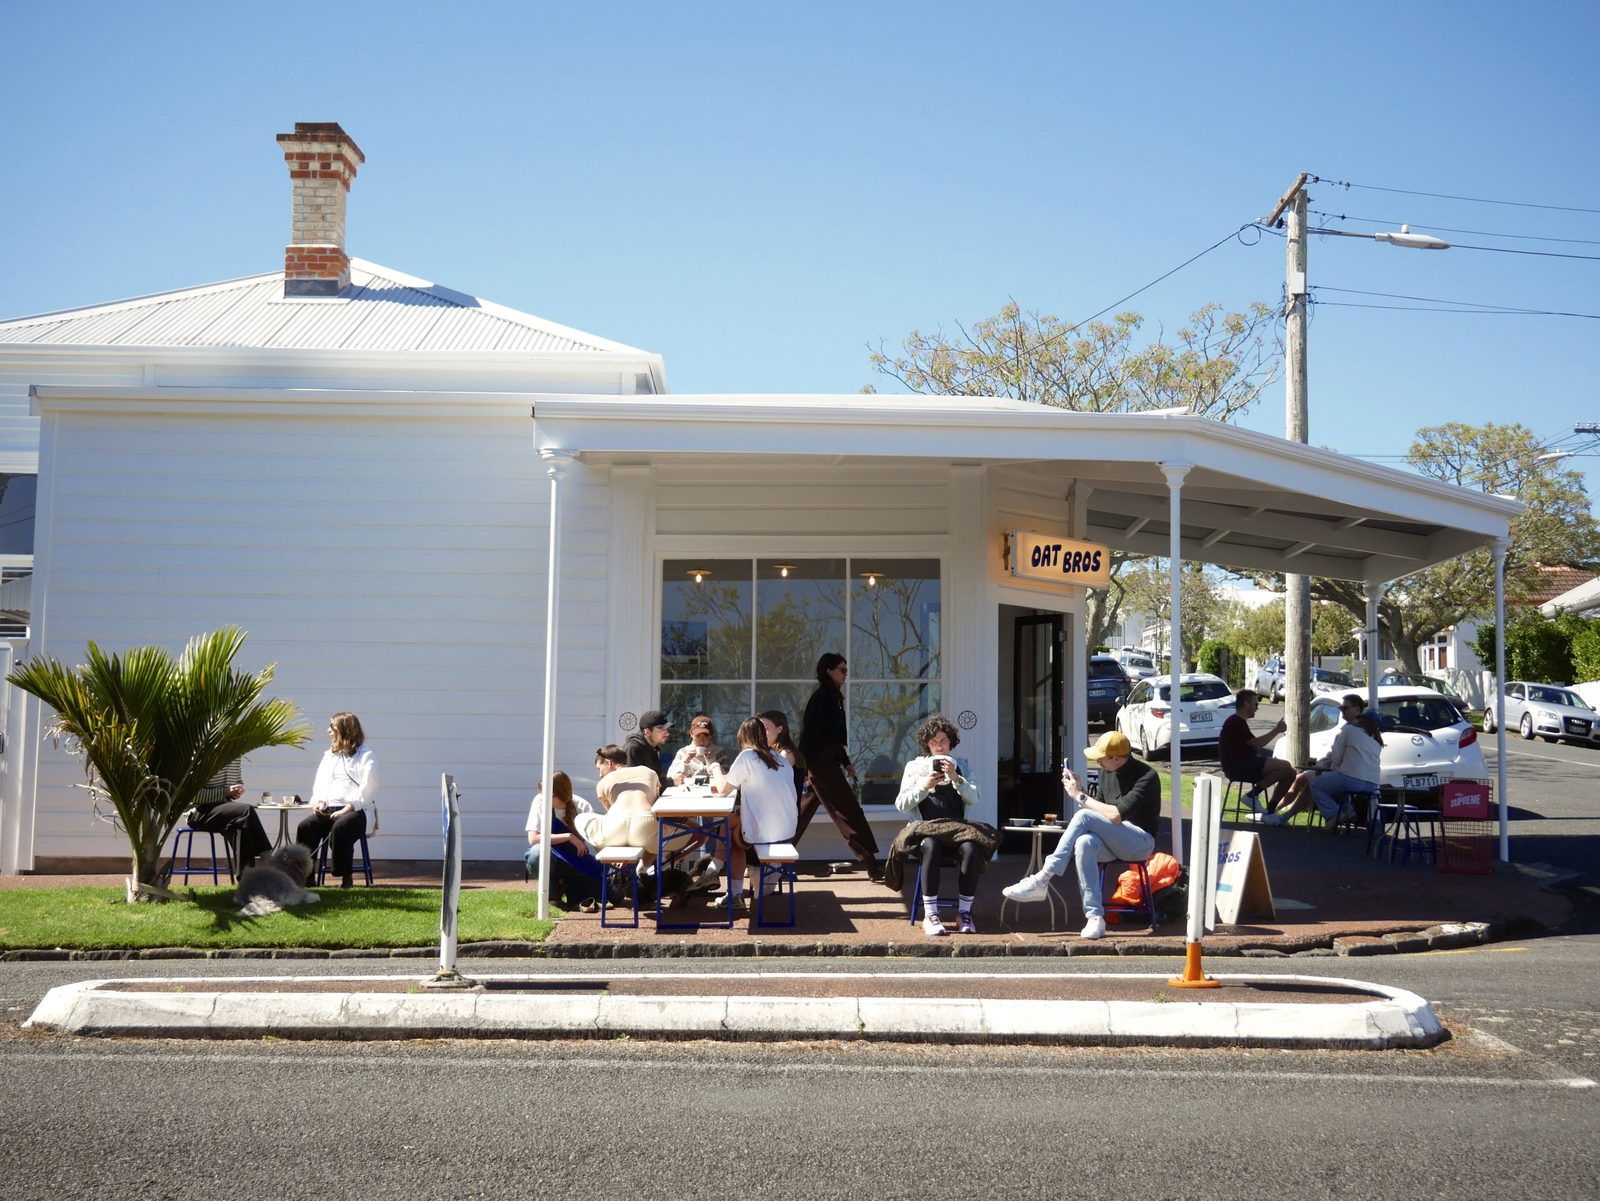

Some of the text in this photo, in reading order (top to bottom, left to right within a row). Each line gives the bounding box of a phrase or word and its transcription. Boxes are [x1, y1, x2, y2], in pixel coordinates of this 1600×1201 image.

[1031, 544, 1102, 573] OAT BROS
[1405, 776, 1437, 788] PLB711
[1450, 794, 1481, 808] SUPREME
